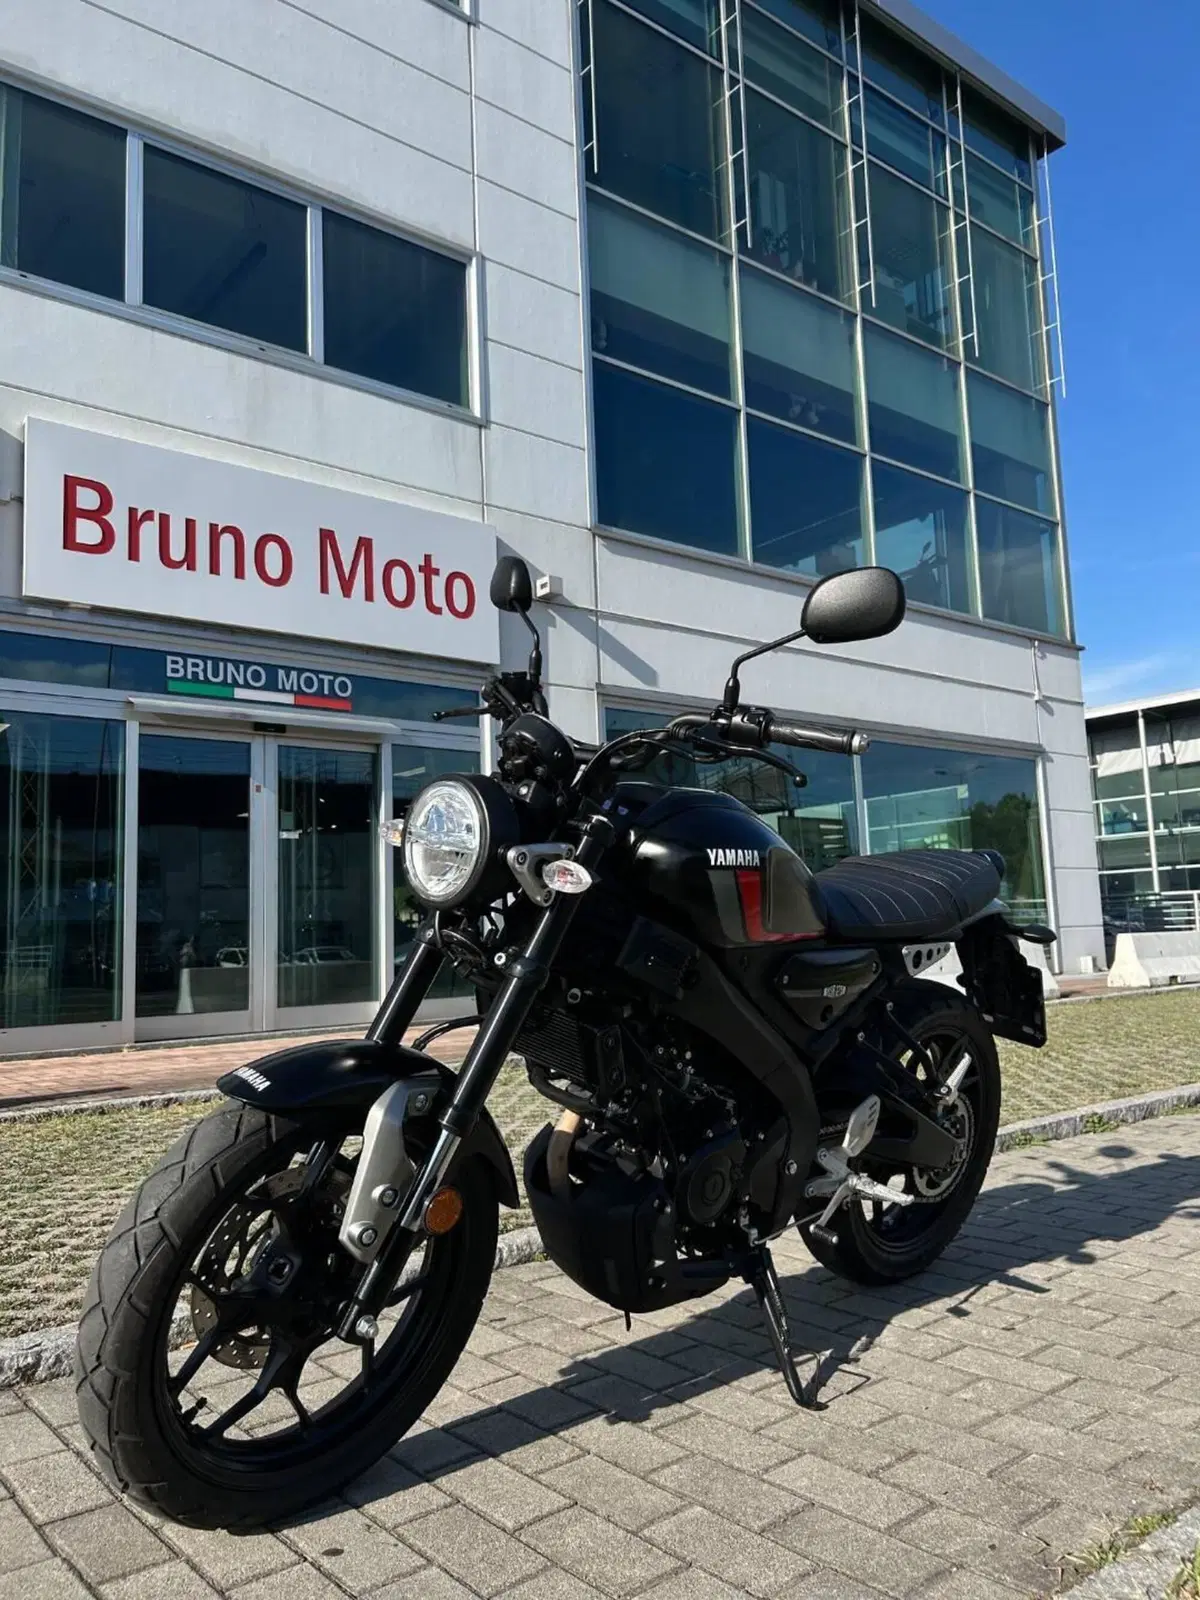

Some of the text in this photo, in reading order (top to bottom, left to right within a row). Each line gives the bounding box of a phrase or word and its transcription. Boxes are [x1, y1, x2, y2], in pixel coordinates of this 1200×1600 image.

[62, 474, 476, 620] Bruno Moto
[166, 655, 352, 697] BRUNO MOTO
[706, 848, 760, 866] YAMAHA
